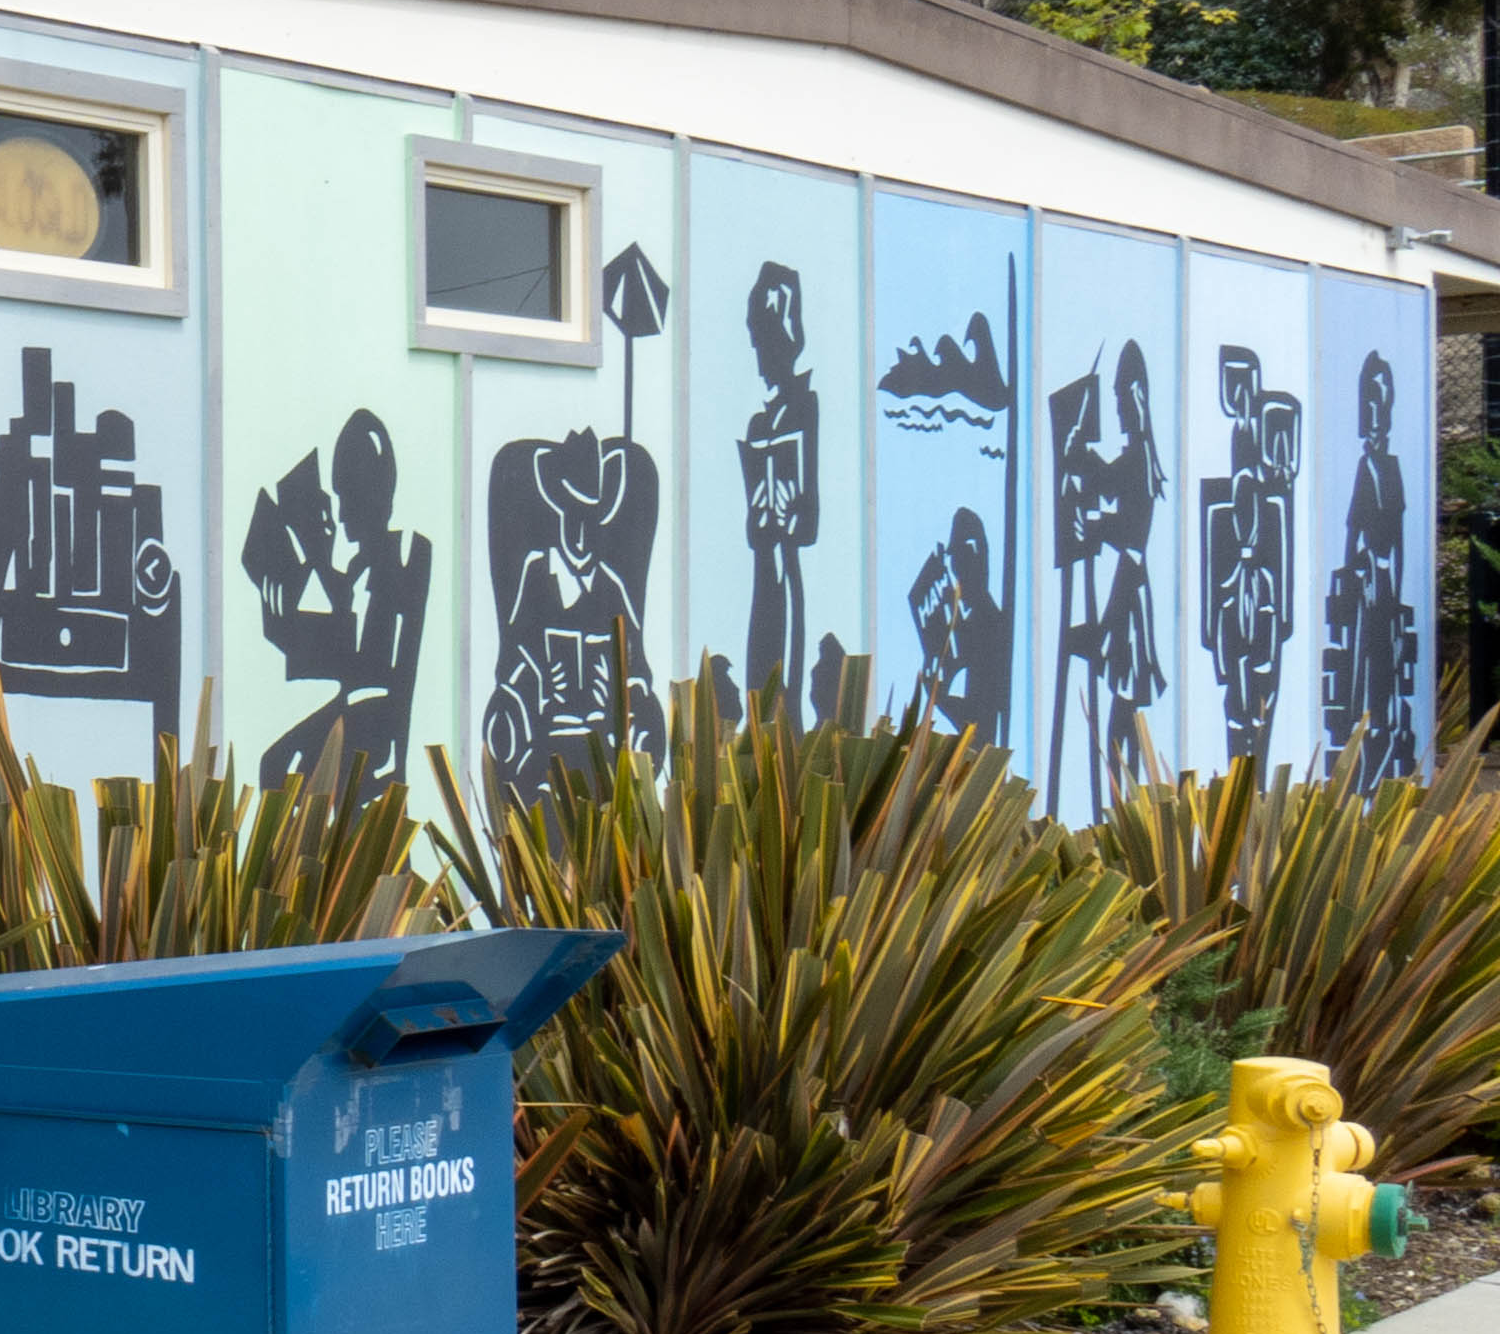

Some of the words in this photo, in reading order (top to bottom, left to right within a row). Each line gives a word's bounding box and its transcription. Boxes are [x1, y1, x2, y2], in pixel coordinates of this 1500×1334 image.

[365, 1119, 439, 1167] PLEASE
[4, 1186, 146, 1234] LIBRARY
[326, 1167, 405, 1216] RETURN
[409, 1156, 475, 1202] BOOKS
[375, 1205, 428, 1250] HERE
[56, 1234, 195, 1284] RETURN
